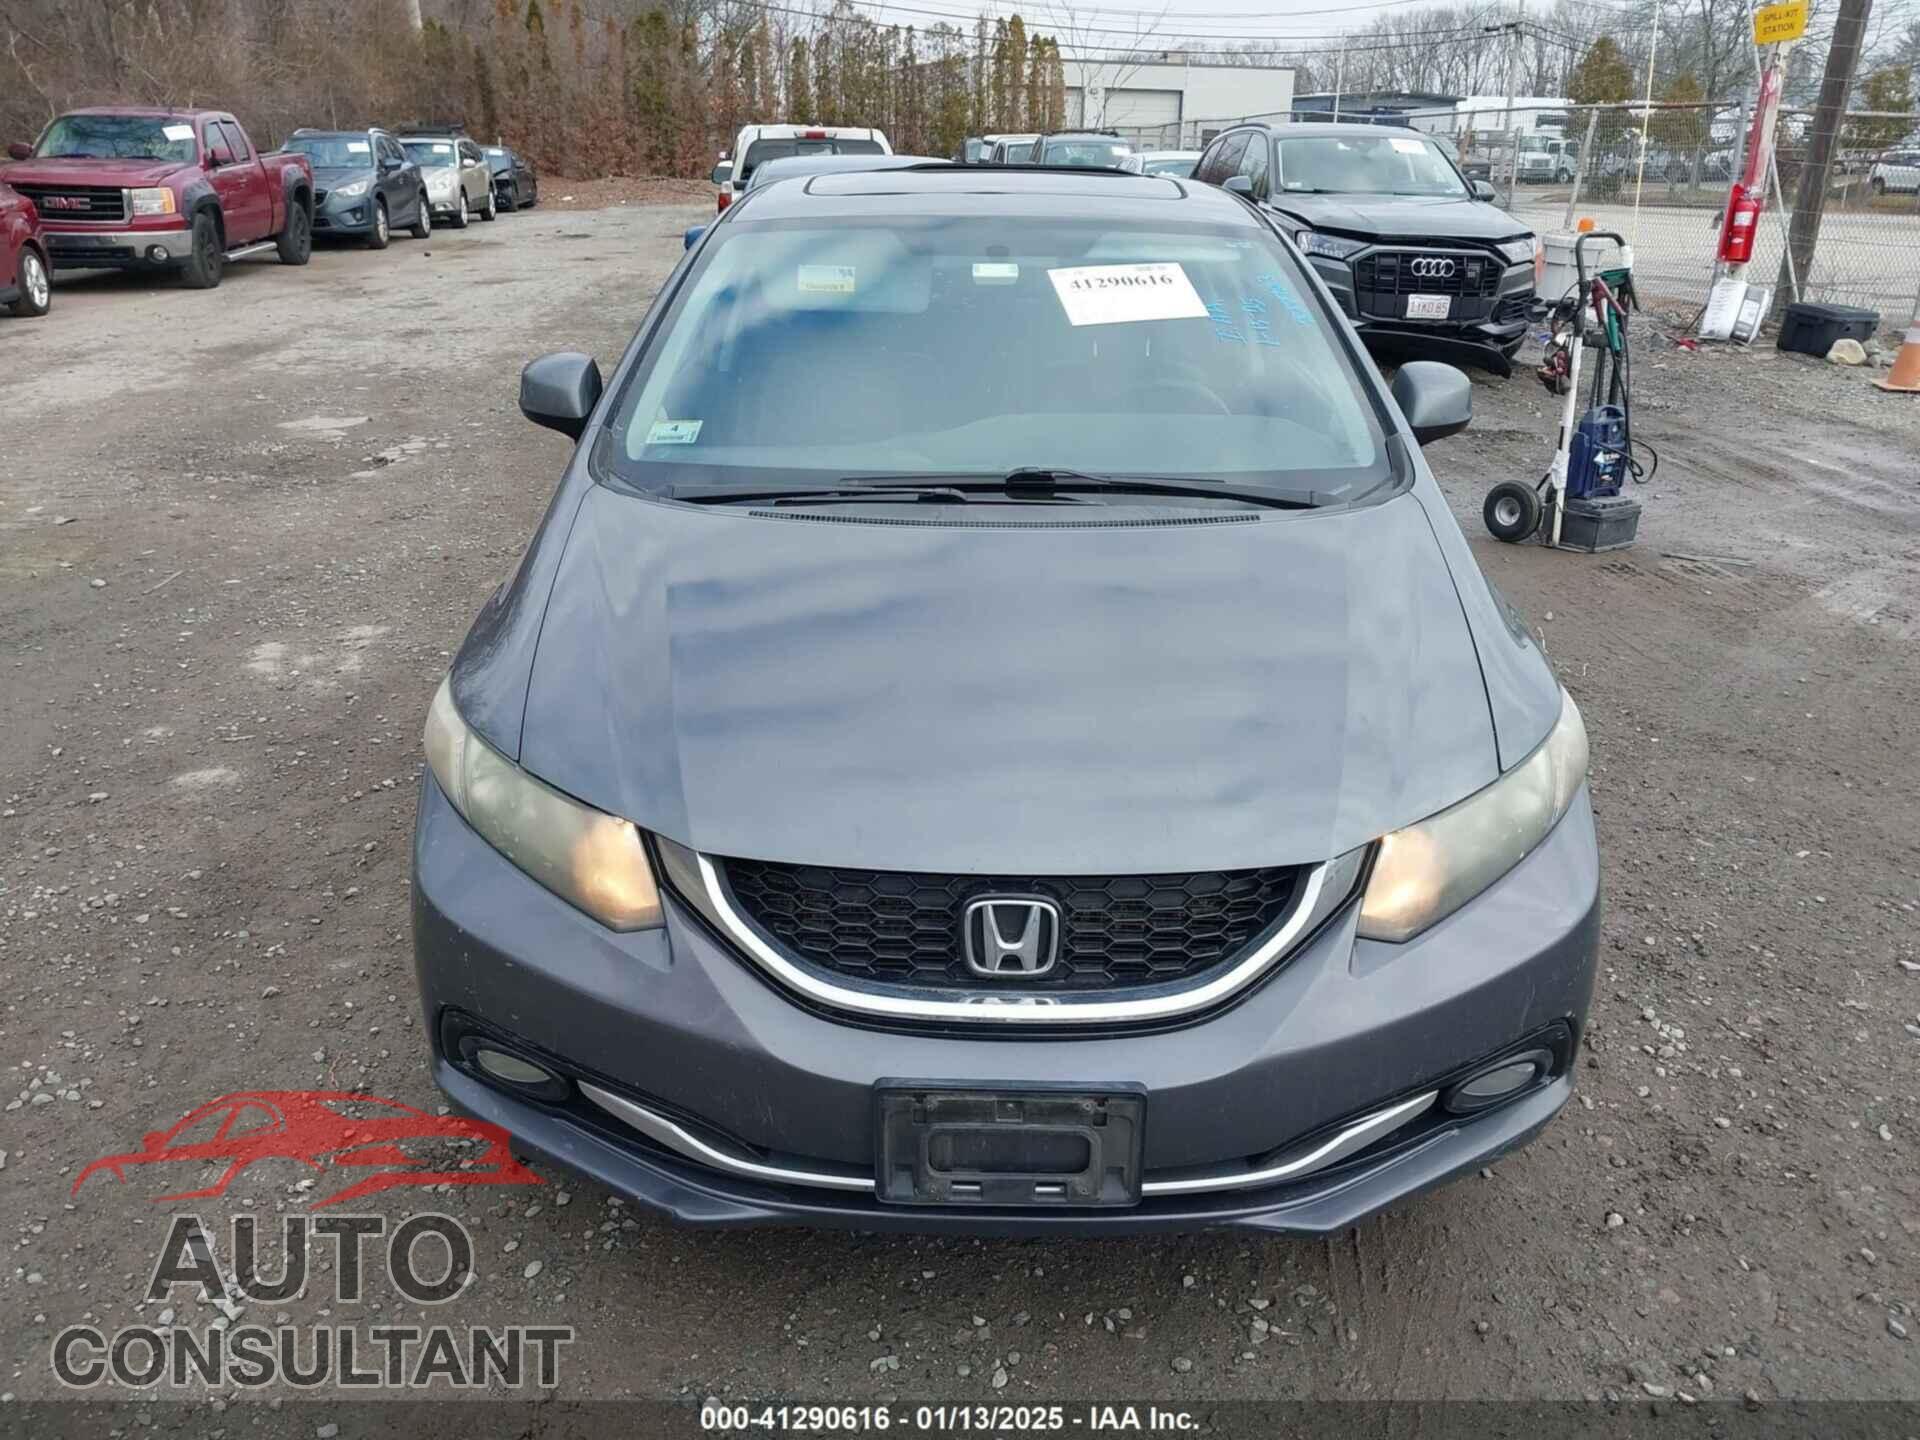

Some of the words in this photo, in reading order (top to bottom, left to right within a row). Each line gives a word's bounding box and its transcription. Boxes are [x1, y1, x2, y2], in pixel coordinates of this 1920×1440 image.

[1762, 22, 1795, 36] STATION
[43, 196, 91, 210] GMC
[1070, 274, 1174, 290] 41290616
